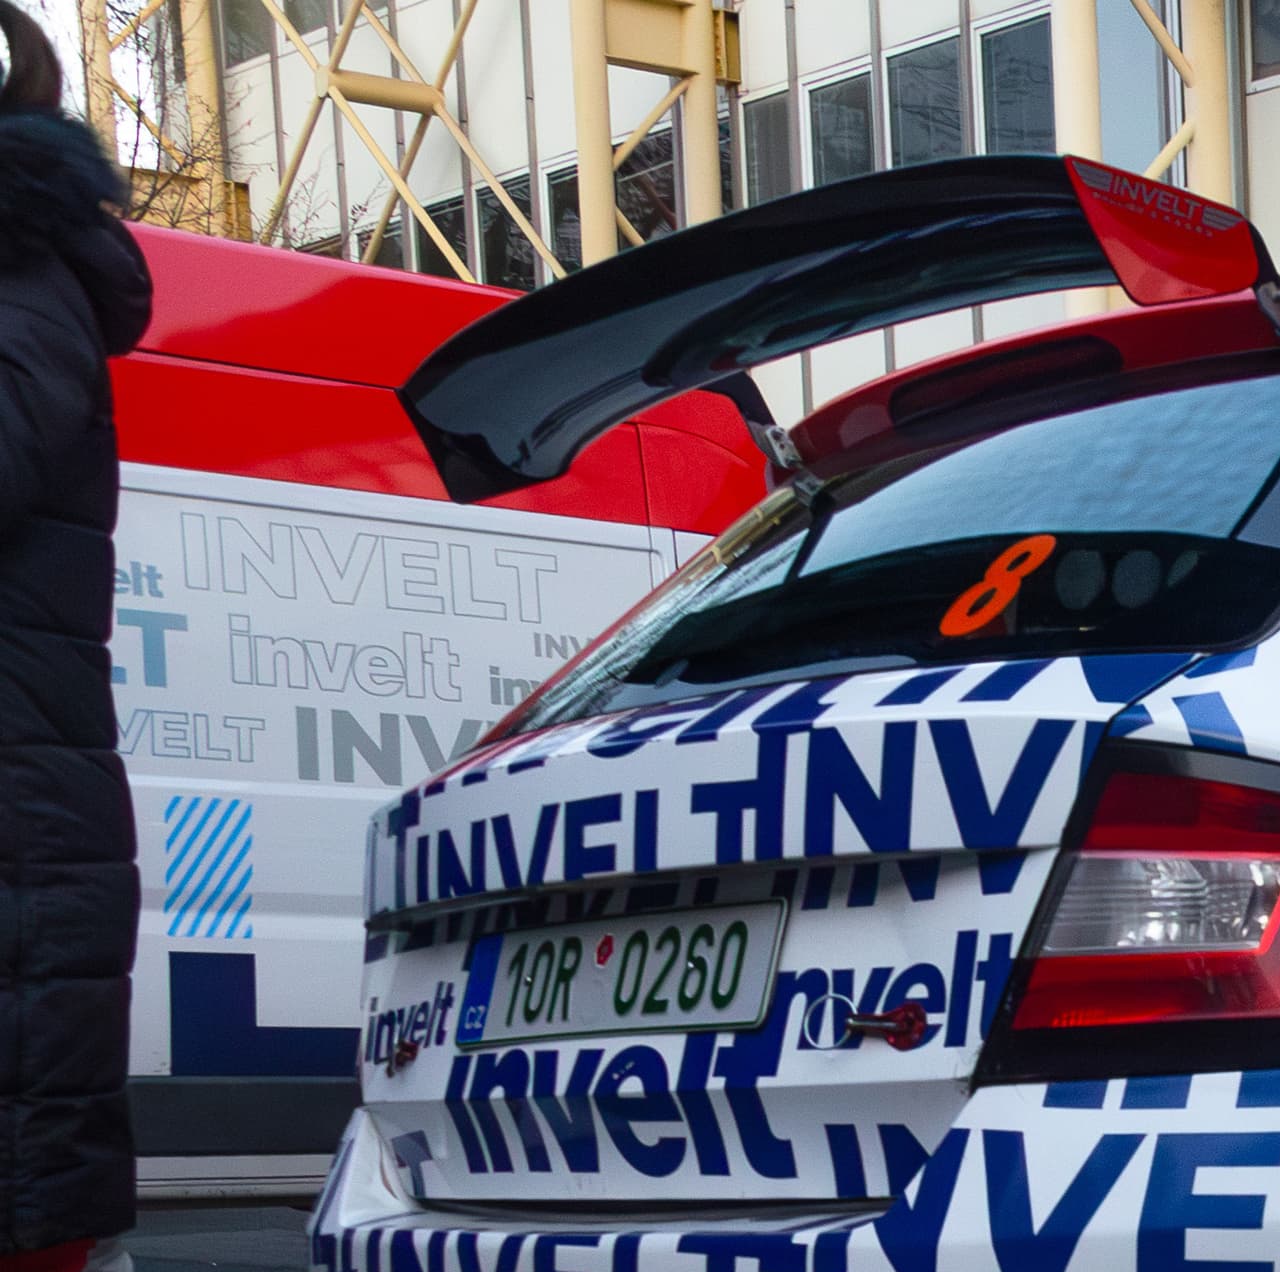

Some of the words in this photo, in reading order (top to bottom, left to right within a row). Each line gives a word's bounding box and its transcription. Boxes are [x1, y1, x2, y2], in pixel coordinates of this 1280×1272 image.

[1113, 175, 1201, 220] INVELT
[180, 512, 559, 624] INVELT
[938, 534, 1057, 638] 8
[228, 613, 463, 702] invelt
[464, 1005, 486, 1030] CZ
[506, 936, 583, 1028] 10R
[613, 919, 748, 1016] 0260
